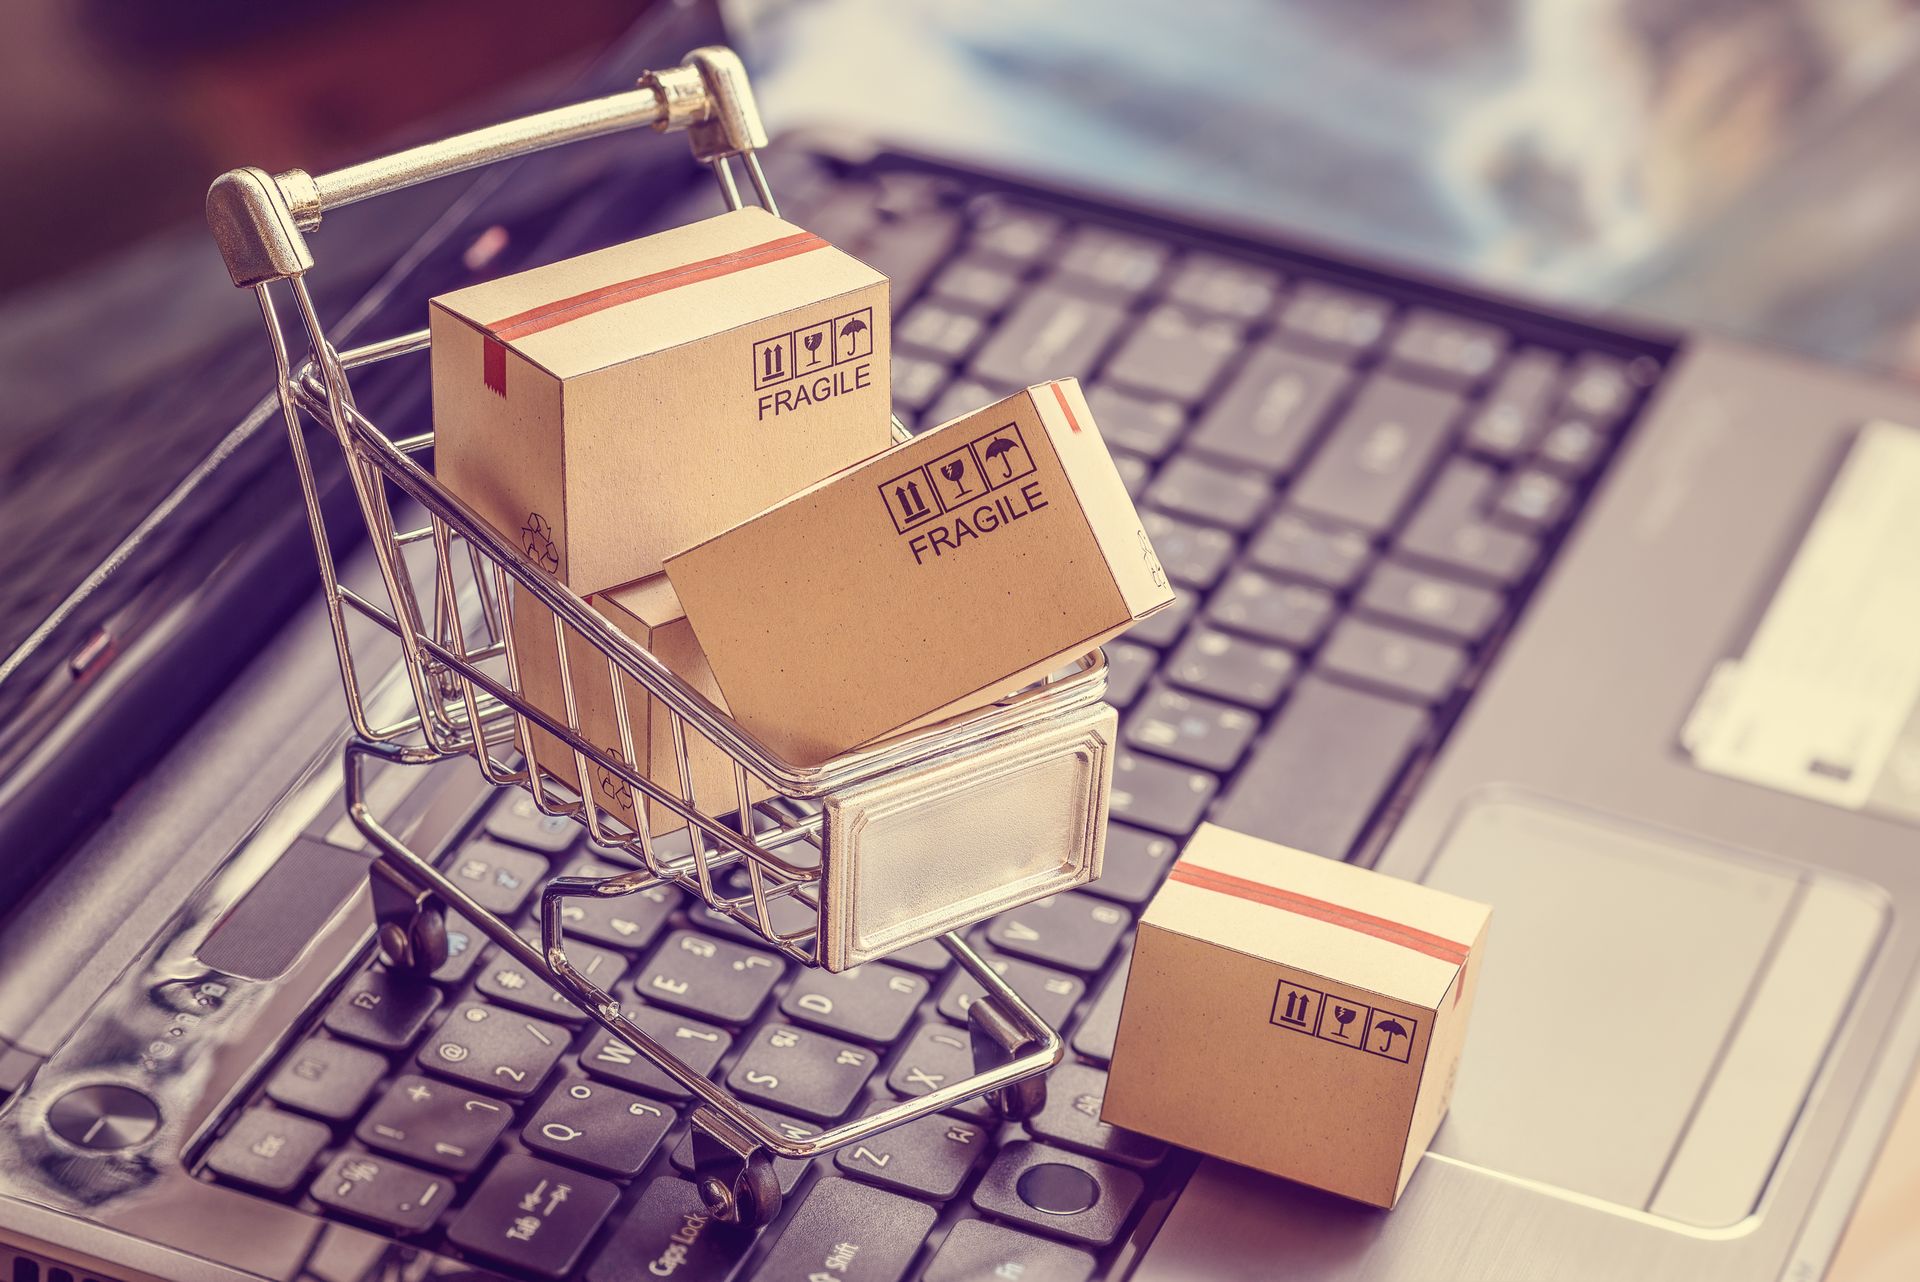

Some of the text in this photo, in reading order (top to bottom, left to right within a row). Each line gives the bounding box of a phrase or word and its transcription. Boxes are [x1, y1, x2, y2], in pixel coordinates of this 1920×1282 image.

[758, 363, 871, 421] FRAGILE
[908, 481, 1048, 565] FRAGILE
[1004, 920, 1040, 941] V
[653, 975, 688, 995] E
[354, 992, 381, 1010] F2
[798, 993, 833, 1015] D
[439, 1042, 468, 1062] @
[597, 1039, 638, 1064] W
[495, 1066, 525, 1082] 2
[747, 1070, 778, 1089] S
[906, 1067, 944, 1090] X
[542, 1123, 583, 1141] Q
[435, 1142, 465, 1158] 1
[854, 1147, 890, 1167] Z
[506, 1215, 541, 1241] Tab
[649, 1213, 709, 1276] Caps Lock
[825, 1242, 859, 1272] Shift
[995, 1262, 1026, 1280] Fn
